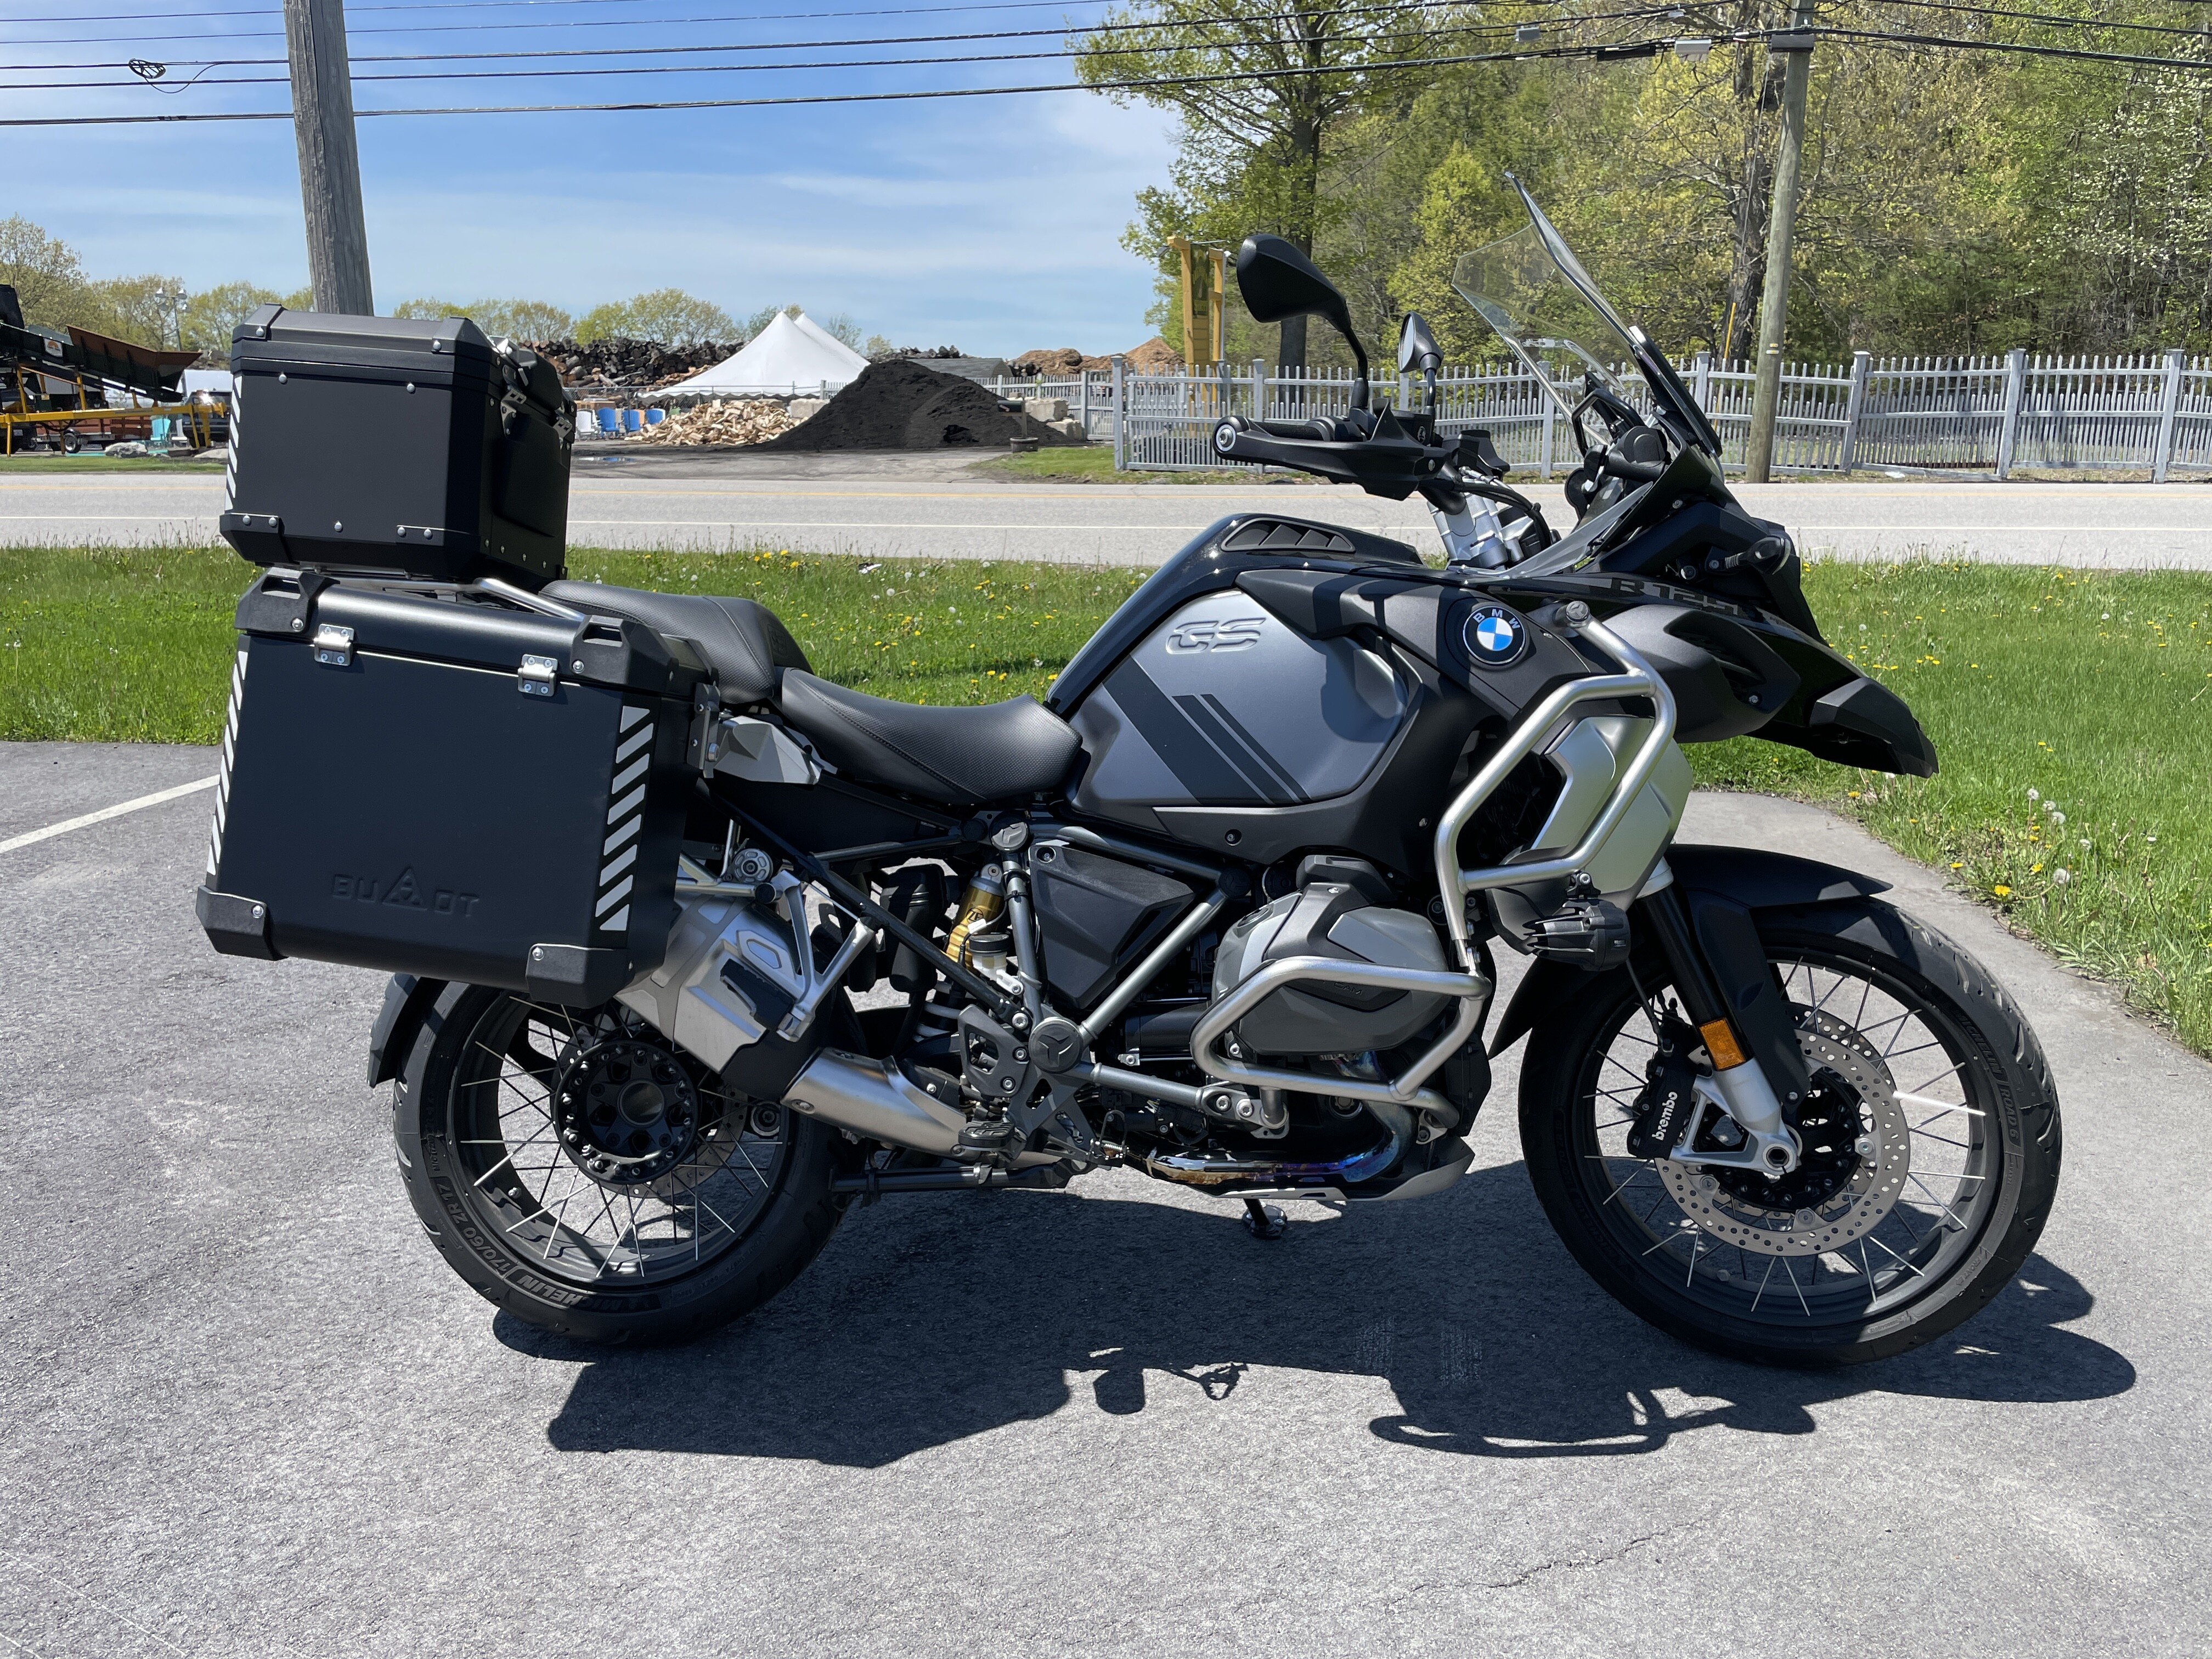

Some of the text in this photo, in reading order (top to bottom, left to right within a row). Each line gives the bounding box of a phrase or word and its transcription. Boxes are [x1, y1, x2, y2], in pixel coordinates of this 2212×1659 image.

[1165, 617, 1266, 654] GS
[1473, 608, 1521, 630] BMW
[1956, 1014, 2019, 1139] MICHELIN ROAD 6
[1651, 1091, 1678, 1141] brembo
[435, 1180, 455, 1203] 17
[444, 1200, 470, 1228] ZR
[460, 1223, 512, 1274] 170/60
[520, 1273, 624, 1312] MICHELIN
